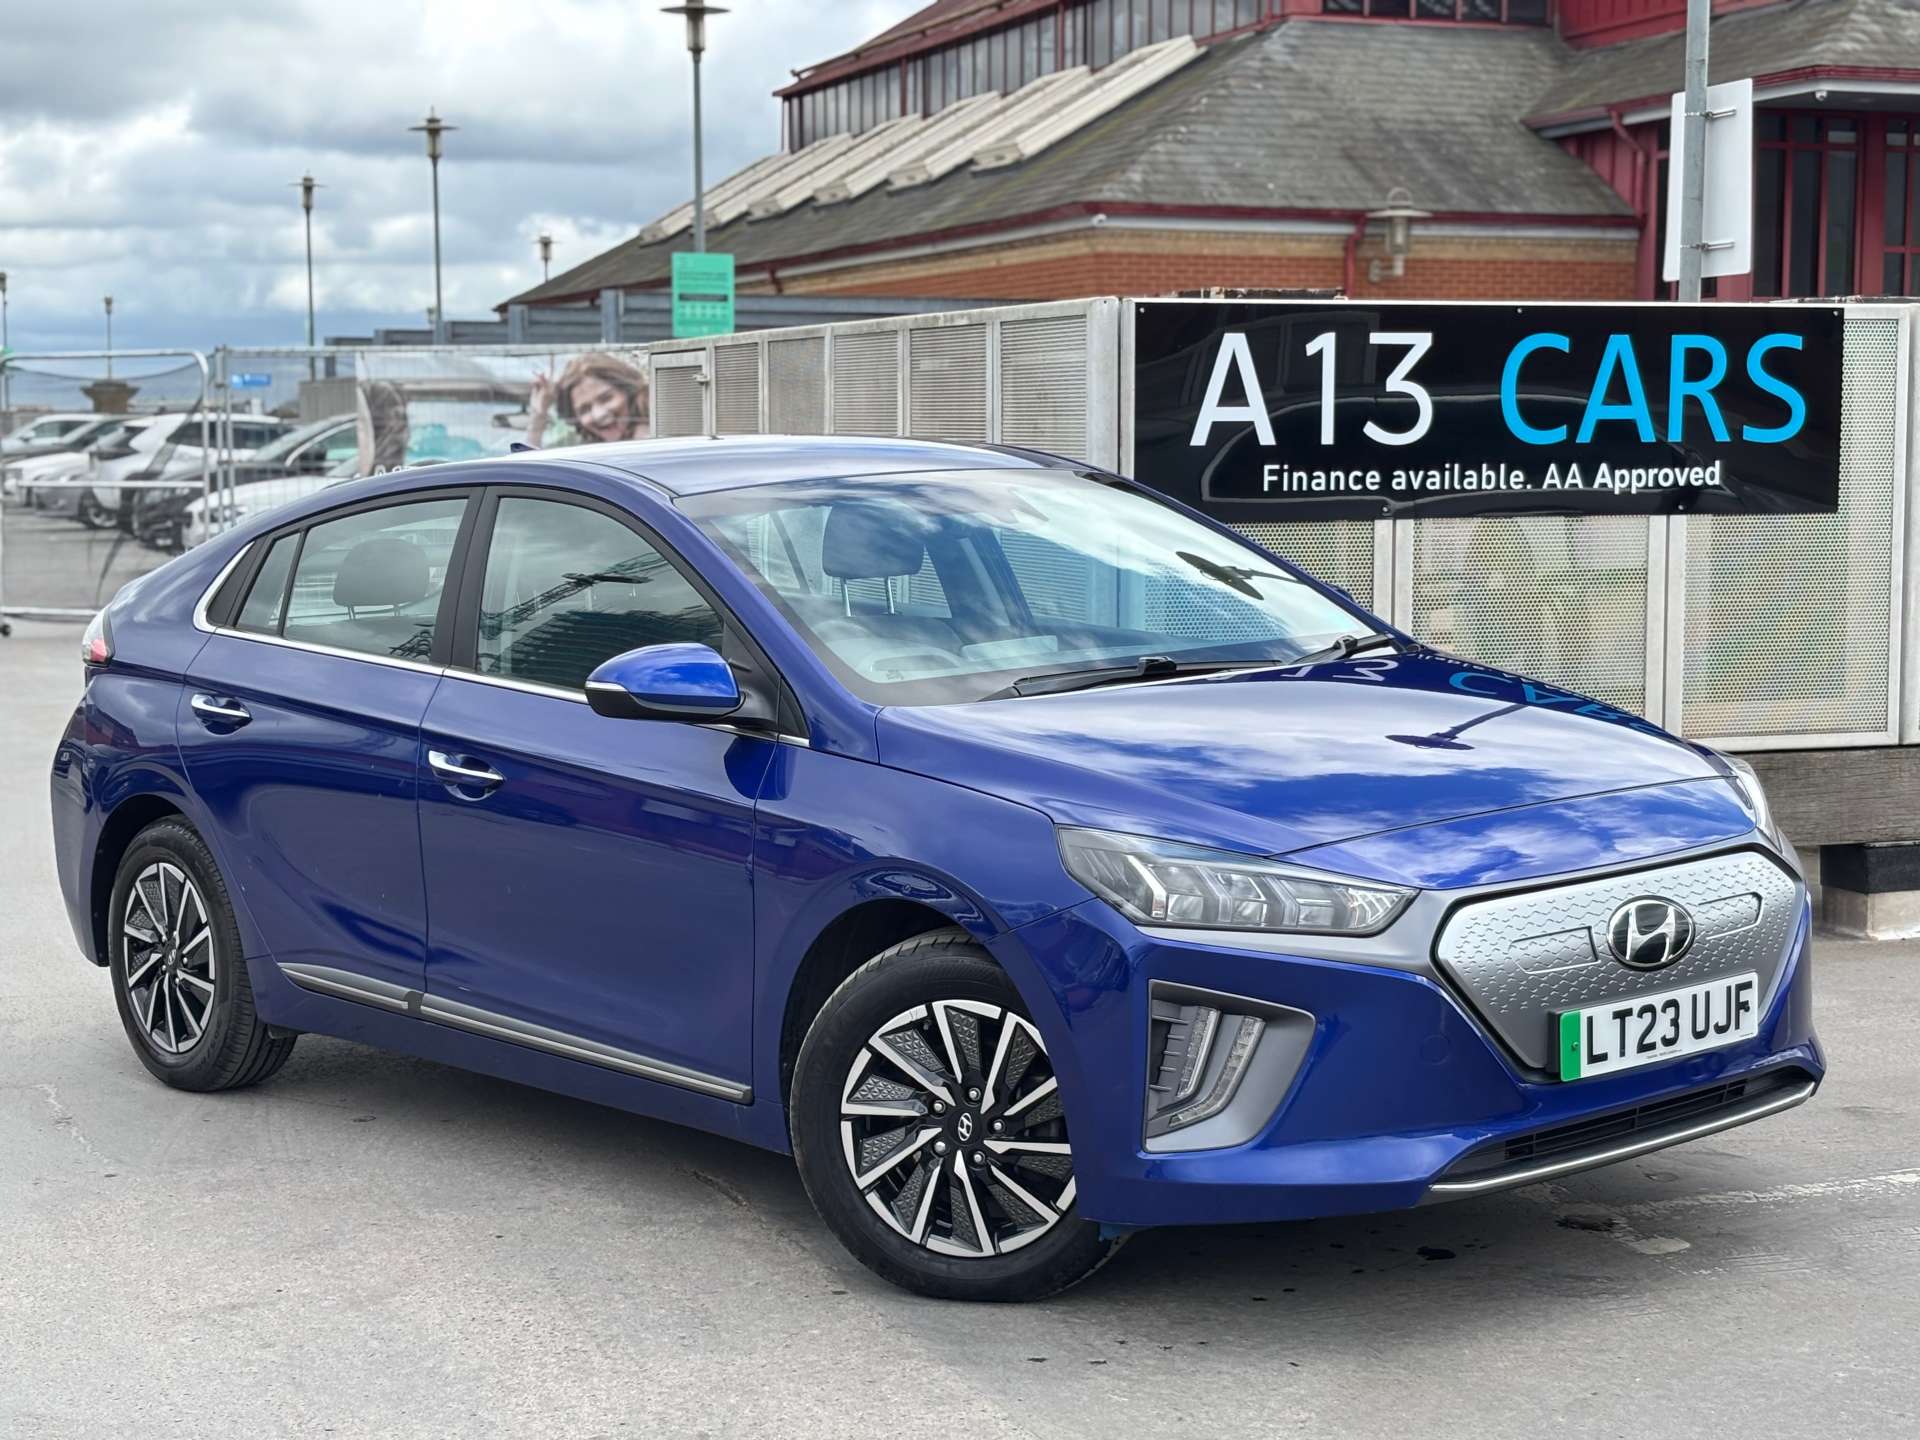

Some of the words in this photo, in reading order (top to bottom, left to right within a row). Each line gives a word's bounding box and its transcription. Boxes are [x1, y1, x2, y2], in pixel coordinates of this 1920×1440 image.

[1189, 331, 1434, 447] A13
[1499, 332, 1807, 445] CARS
[1262, 464, 1382, 492] Finance
[1391, 463, 1534, 491] available.
[1541, 462, 1592, 491] AA
[1592, 459, 1722, 495] Approved
[1586, 998, 1681, 1065] LT23
[1691, 980, 1753, 1040] UJF
